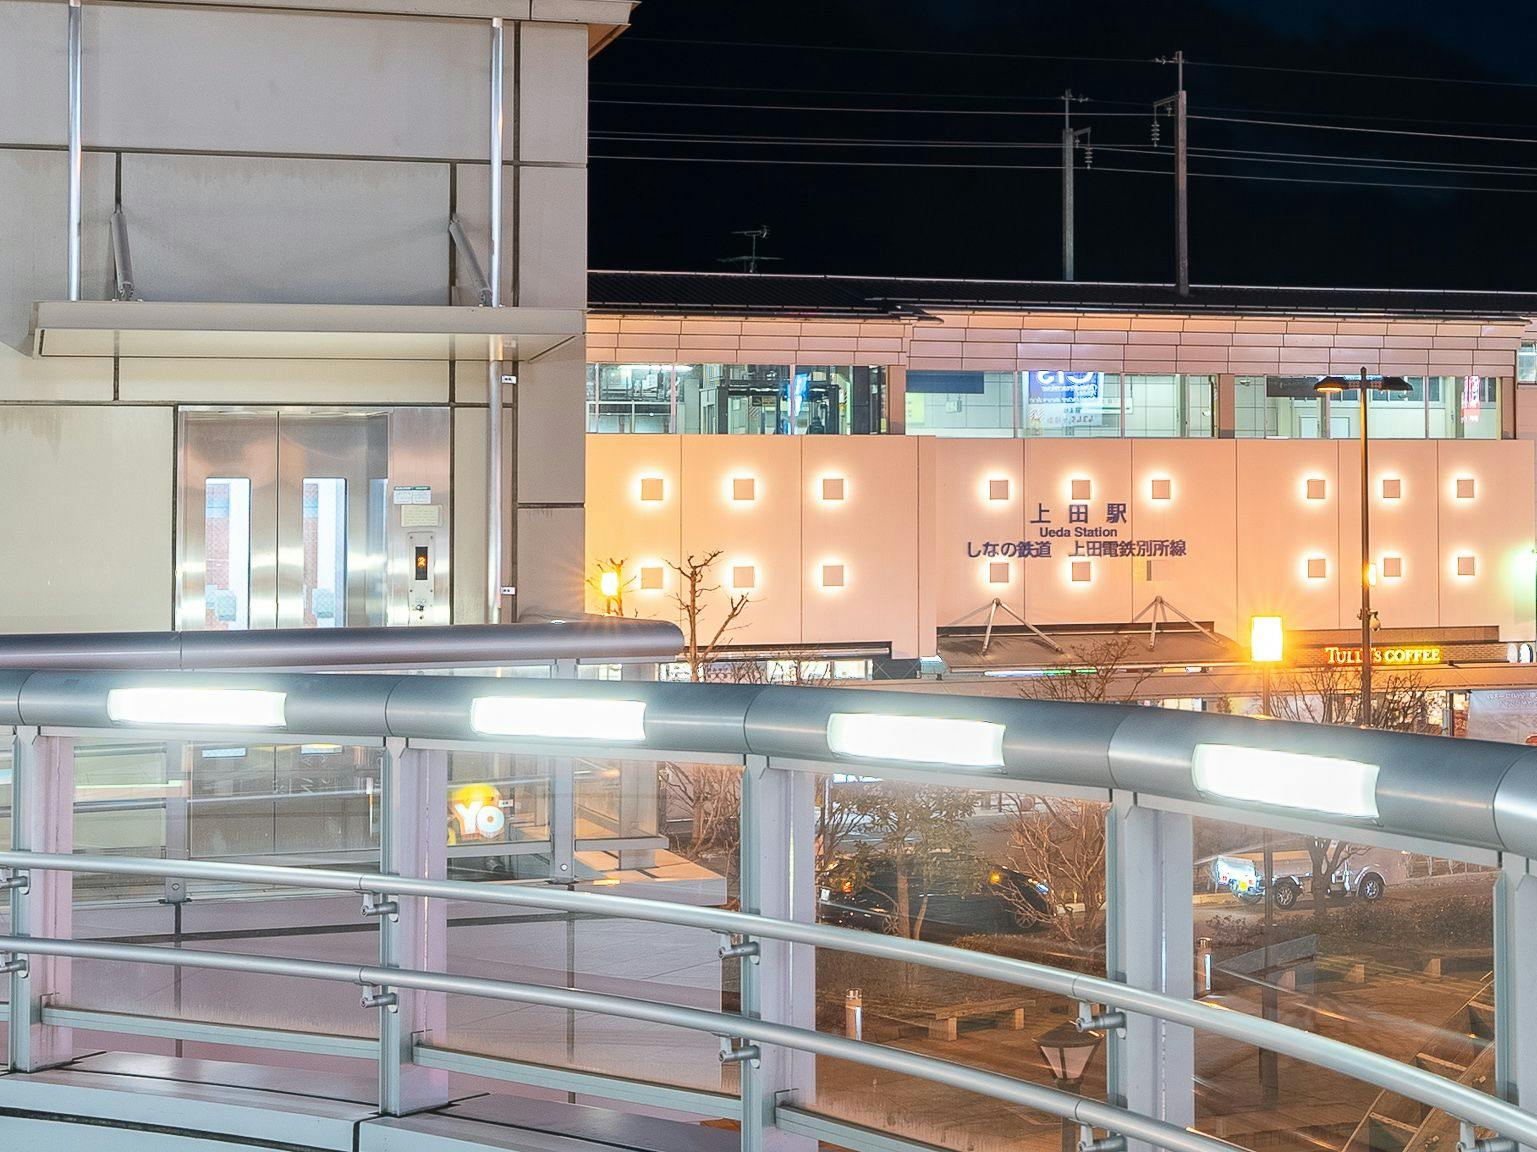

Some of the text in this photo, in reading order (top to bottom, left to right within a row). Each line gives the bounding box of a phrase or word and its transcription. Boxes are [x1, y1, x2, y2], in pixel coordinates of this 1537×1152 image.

[1030, 503, 1128, 524] 上田駅
[1039, 526, 1118, 538] Ueda Station
[967, 539, 1187, 558] しなの鉄道 上田電鉄別所線
[1384, 648, 1441, 663] COFFEE
